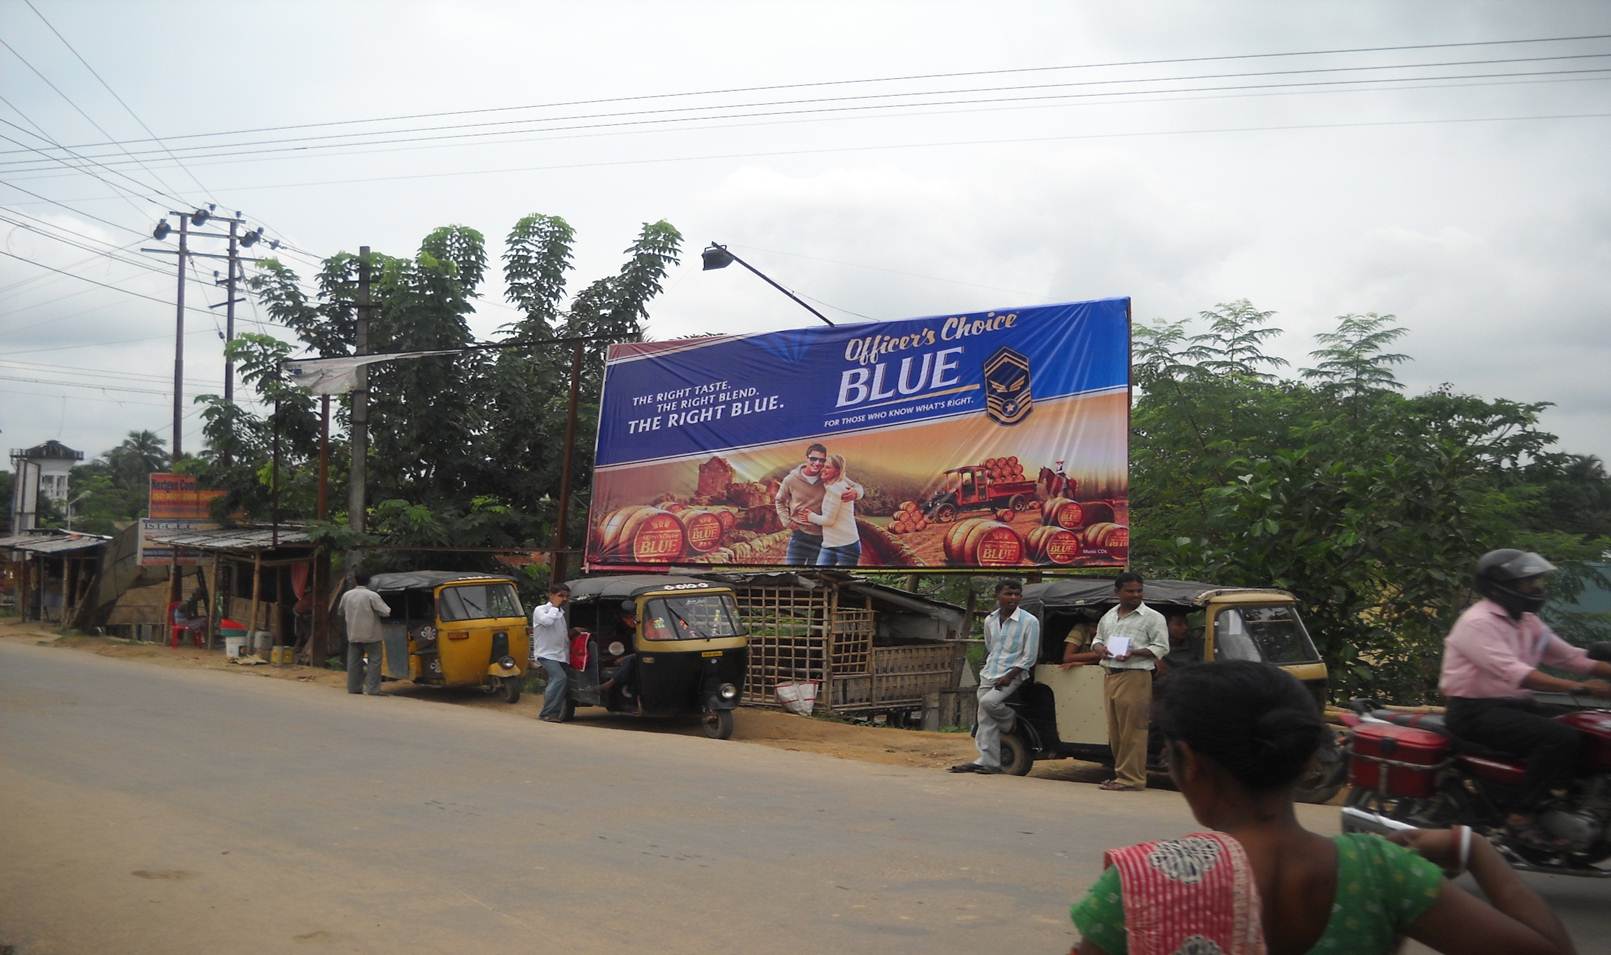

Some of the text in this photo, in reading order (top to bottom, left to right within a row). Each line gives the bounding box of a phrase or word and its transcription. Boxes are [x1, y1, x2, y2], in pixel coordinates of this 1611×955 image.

[844, 311, 1018, 366] Officer's Choice
[835, 346, 965, 408] BLUE
[633, 380, 732, 407] THE RIGHT TASTE.
[656, 387, 760, 413] THE RIGHT BLEND.
[628, 395, 785, 434] THE RIGHT BLUE.
[824, 418, 840, 427] FOR
[841, 414, 865, 425] THOSE
[866, 411, 887, 421] WHO
[888, 406, 914, 417] KNOW
[915, 400, 946, 413] WHAT'S
[640, 540, 678, 554] BLUE
[692, 527, 717, 540] BLUE
[983, 548, 1016, 561] BLUE
